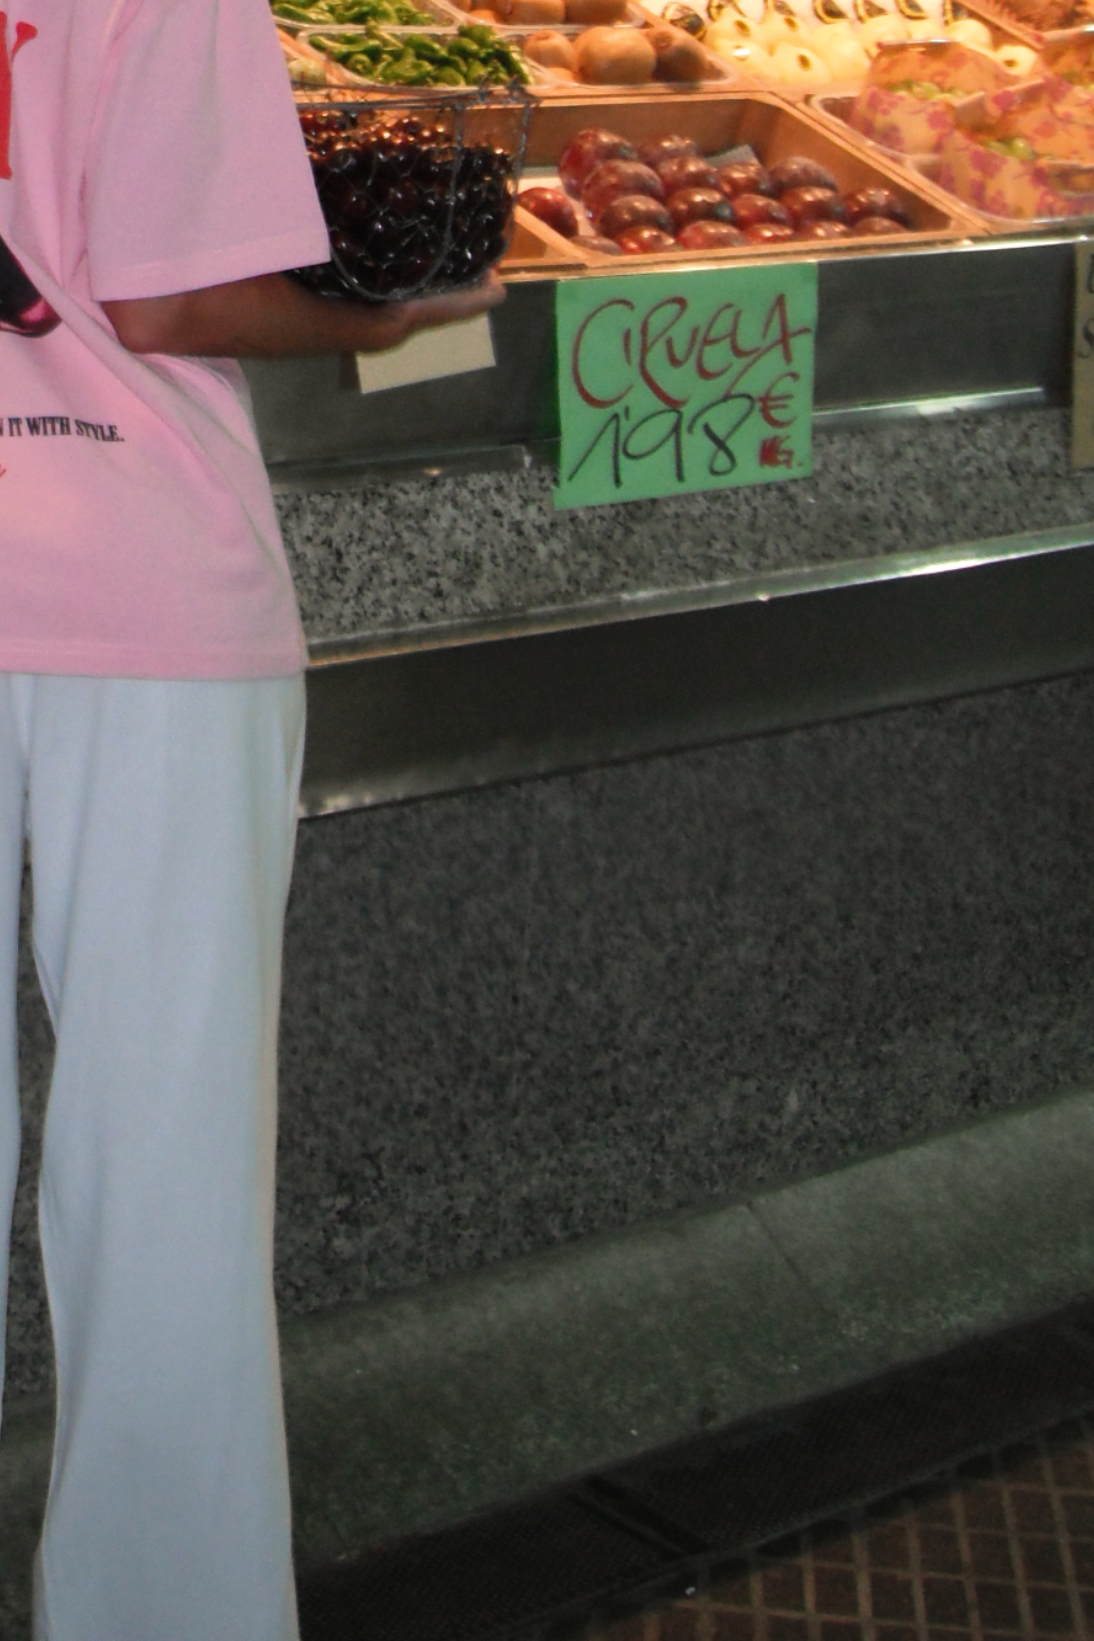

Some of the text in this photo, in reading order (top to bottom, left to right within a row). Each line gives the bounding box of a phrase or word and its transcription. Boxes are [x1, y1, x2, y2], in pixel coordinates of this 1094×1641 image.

[572, 293, 812, 409] CIRUELA
[7, 416, 23, 437] IT
[25, 416, 72, 436] WITH
[759, 371, 801, 429] €
